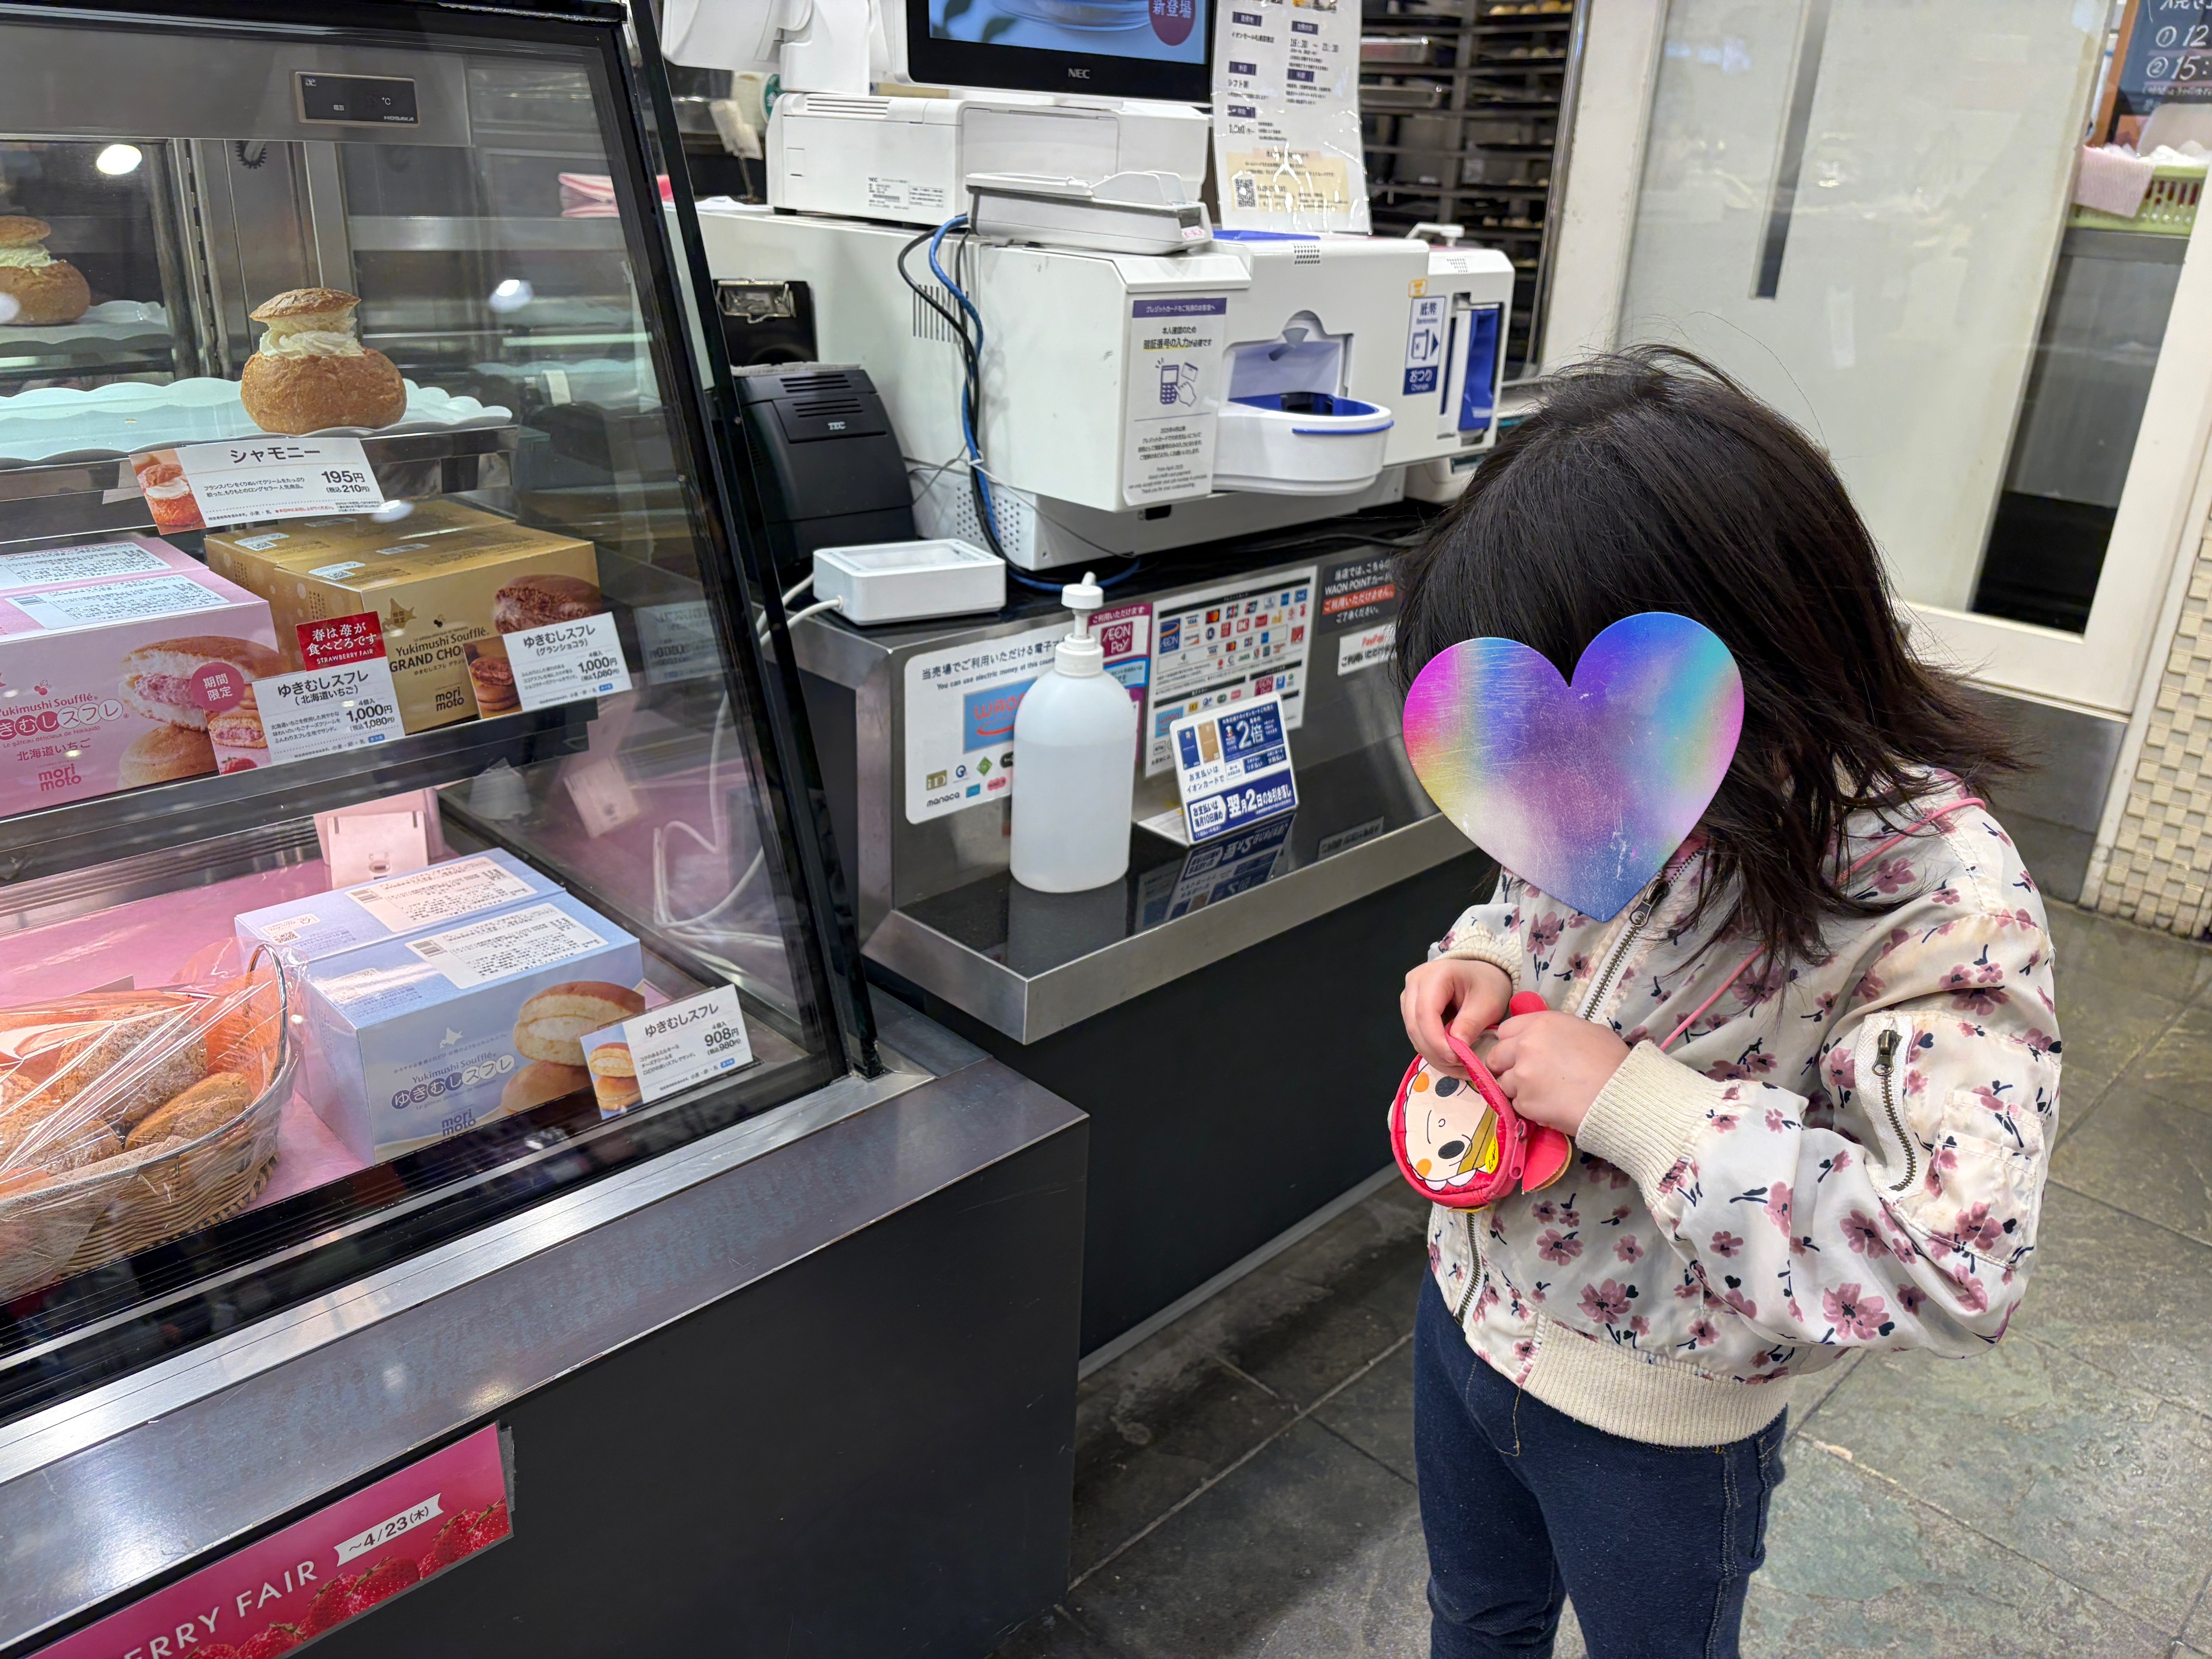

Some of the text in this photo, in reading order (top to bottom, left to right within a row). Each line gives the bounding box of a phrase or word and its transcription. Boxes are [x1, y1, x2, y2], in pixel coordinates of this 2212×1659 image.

[1152, 0, 1192, 18] 新登場
[1067, 68, 1091, 79] NEC
[1143, 338, 1212, 350] 暗証番号の入力が必要です
[1409, 368, 1433, 383] おつり
[827, 421, 846, 430] TEC
[230, 447, 320, 463] シャモニー
[204, 477, 305, 491] フランスパンをくりぬいてクリームをたっぷり
[321, 470, 365, 483] 195円
[1325, 582, 1348, 596] WAON
[1324, 587, 1394, 611] ご利用いただけません。
[1092, 606, 1145, 623] ご利用いただけます
[1336, 606, 1379, 624] ご了承ください。
[312, 622, 366, 642] 春は苺が
[523, 624, 596, 649] ゆきむしスフレ
[306, 633, 377, 657] 食べごろです
[396, 626, 487, 657] Yukimushi Soufflé
[1111, 638, 1129, 654] Pay
[316, 651, 358, 665] STRAWBERRY
[389, 645, 464, 672] GRAND CHO
[578, 656, 618, 674] 1,000円
[203, 673, 229, 689] 期間
[278, 670, 368, 698] ゆきむしスフレ
[937, 682, 948, 691] You
[975, 670, 998, 682] electric
[999, 666, 1019, 677] money
[1027, 660, 1038, 669] this
[55, 693, 93, 707] Soufflé
[207, 686, 233, 702] 限定
[295, 685, 359, 706] (北海道いちご)
[435, 686, 461, 703] mori
[346, 704, 393, 723] 1,000円
[436, 697, 464, 712] moto
[1236, 720, 1264, 750] 2倍
[17, 738, 91, 761] 北海道いちご
[38, 763, 76, 782] mori
[1189, 765, 1218, 781] お支払いは
[40, 774, 82, 792] moto
[927, 775, 947, 789] iD
[1186, 774, 1225, 793] イオンカードで
[927, 792, 960, 807] manaca
[1192, 799, 1218, 817] お支払いは
[1226, 784, 1292, 819] 翌月2日のお引き落し
[1194, 811, 1224, 828] 毎月10日締め
[645, 1003, 719, 1038] ゆきむしスフレ
[704, 1027, 740, 1047] 908円
[412, 1051, 492, 1084] Yukimushi Soufflé
[394, 1058, 512, 1107] ゆきむしスフレ
[442, 1108, 473, 1129] mori
[442, 1118, 476, 1137] moto
[235, 1560, 319, 1618] FAIR
